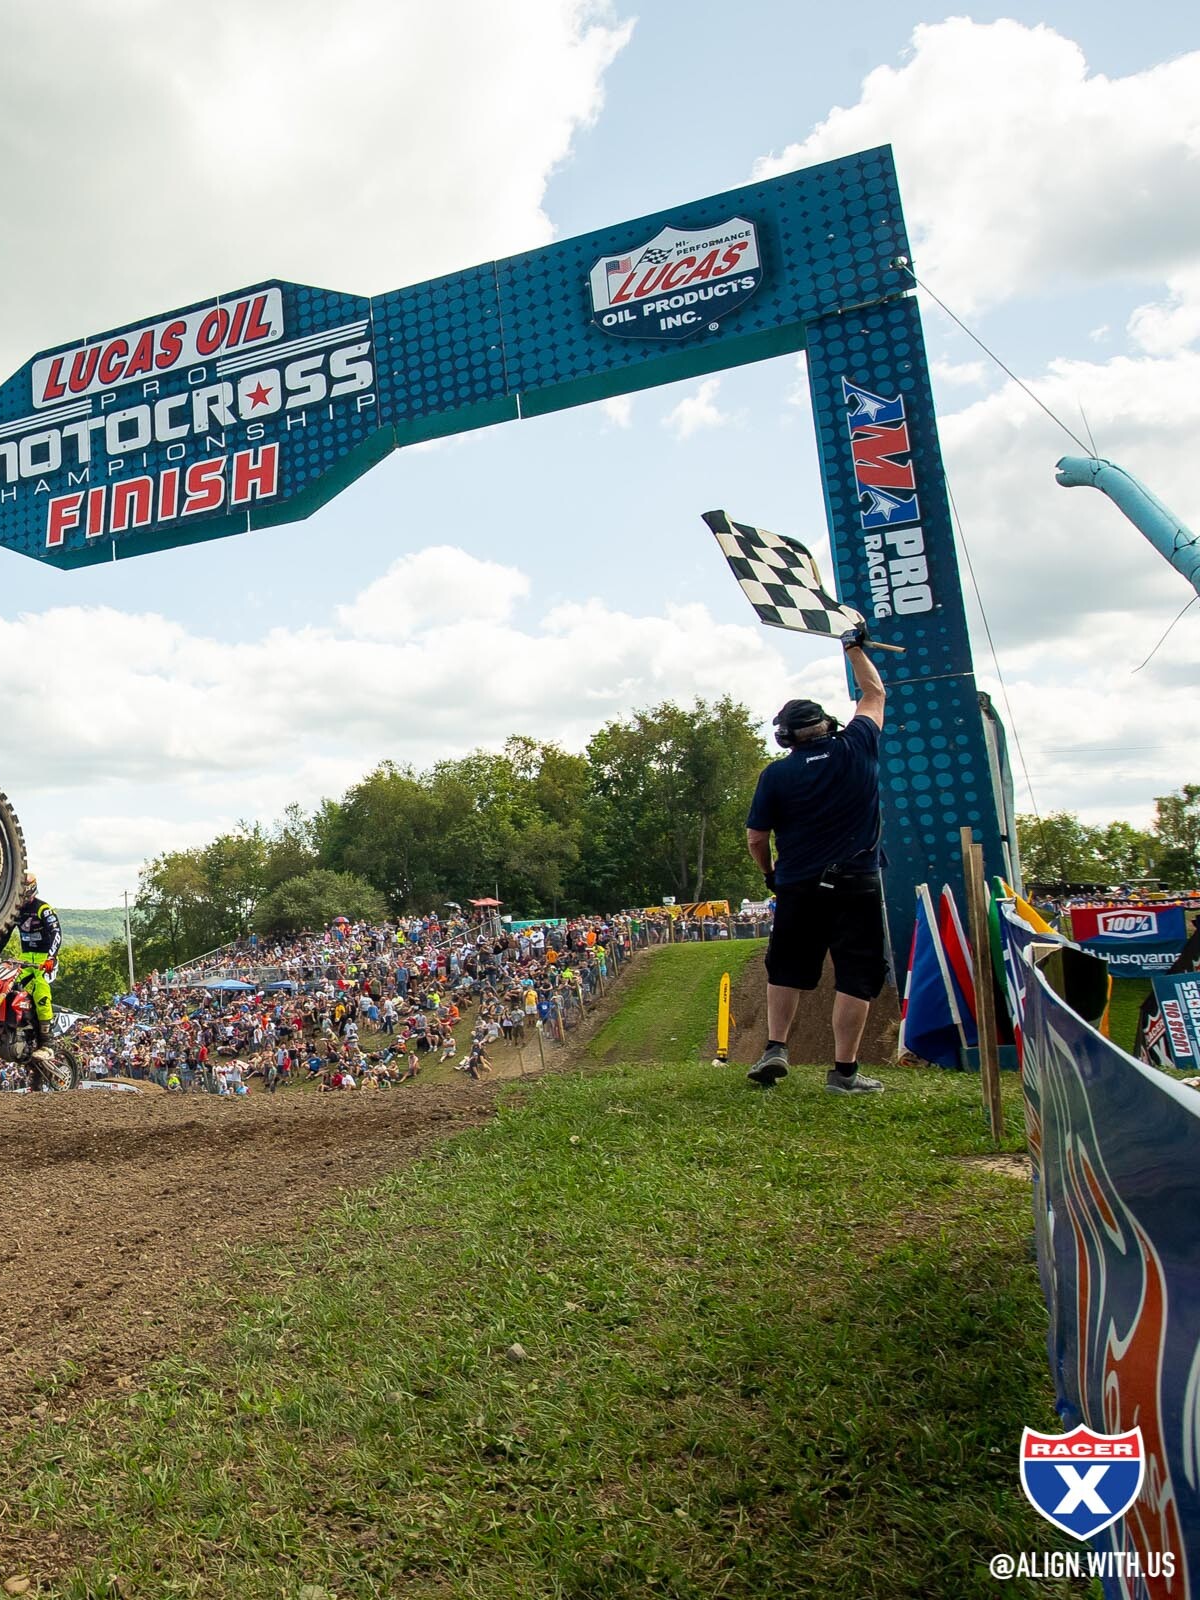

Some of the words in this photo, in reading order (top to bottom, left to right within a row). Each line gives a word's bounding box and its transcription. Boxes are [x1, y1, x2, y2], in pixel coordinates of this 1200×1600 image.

[676, 230, 752, 256] PERFORMANCE
[609, 241, 749, 305] LUCAS
[602, 310, 637, 327] OIL
[643, 276, 756, 316] PRODUCTS
[660, 311, 702, 331] INC.
[42, 320, 187, 402] LUCAS
[196, 294, 274, 357] OIL
[101, 366, 207, 409] PRO
[842, 376, 920, 529] AMA
[45, 442, 281, 548] FINISH
[864, 533, 892, 618] RACING
[885, 527, 933, 615] PRO
[1106, 916, 1149, 932] 100%
[1164, 1002, 1181, 1018] OIL
[1169, 1020, 1191, 1054] LUCAS
